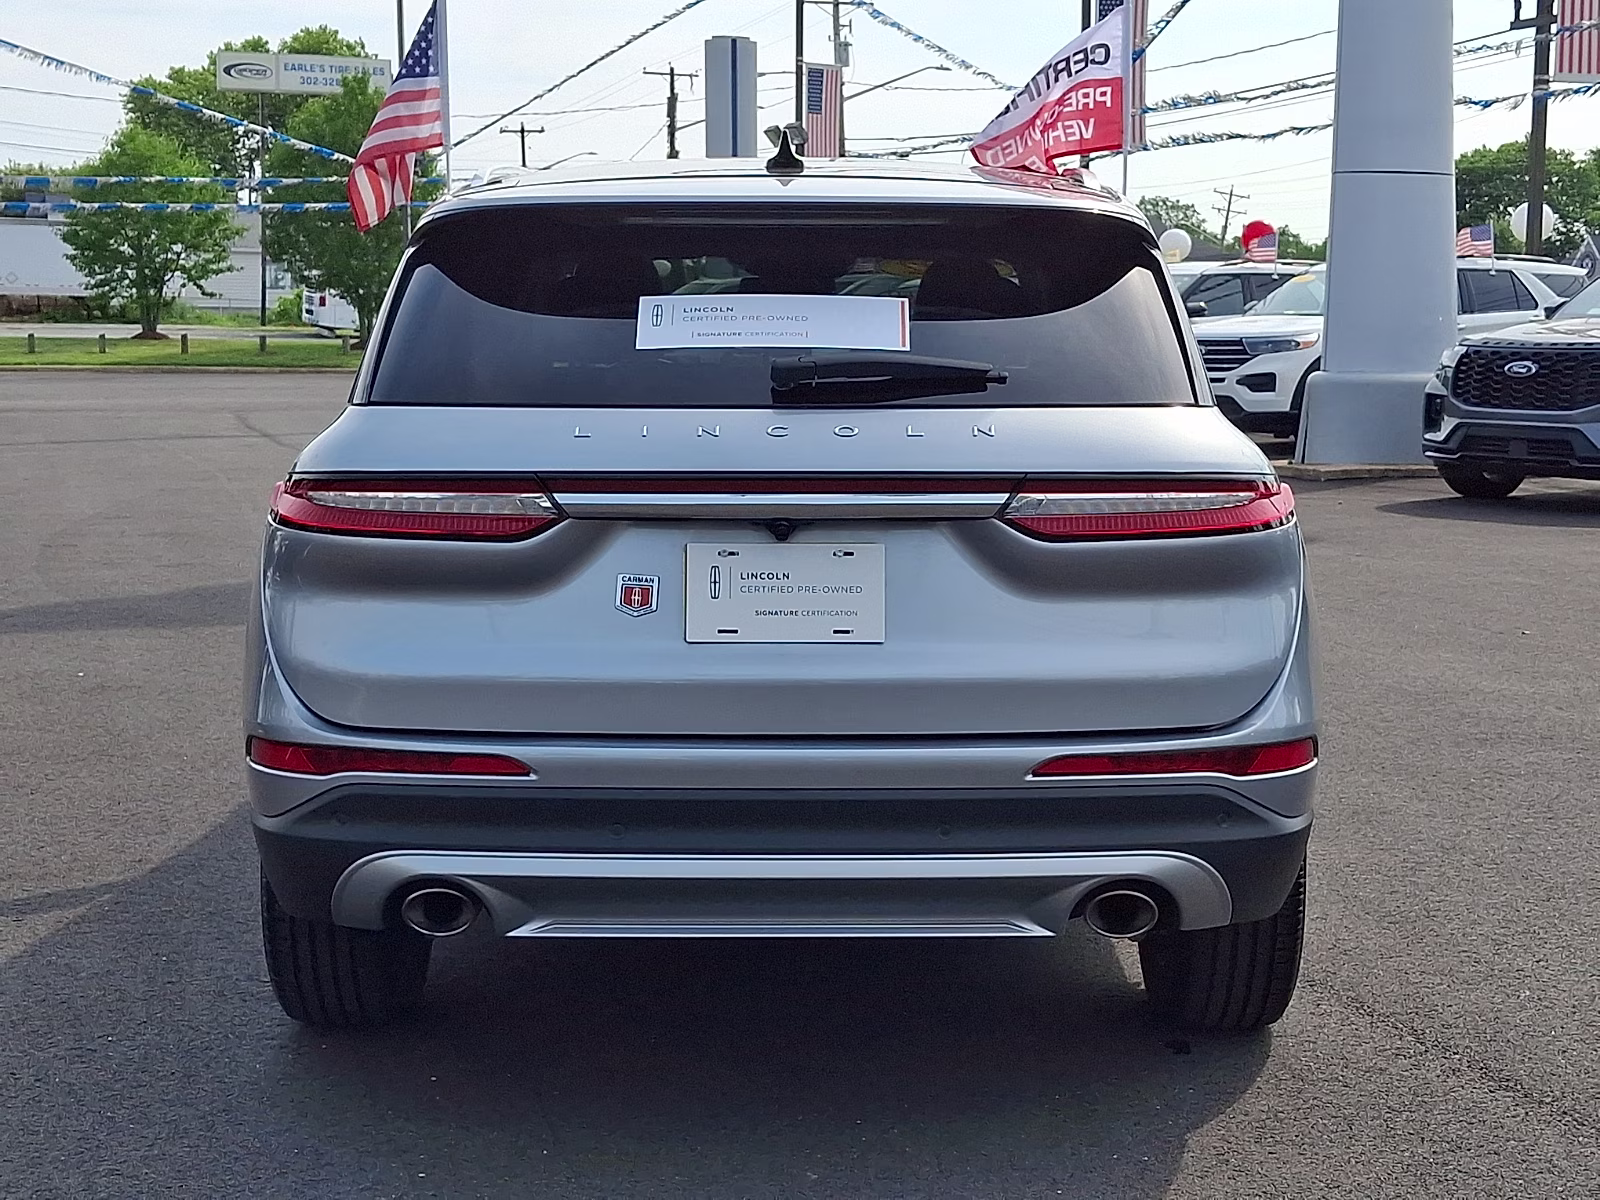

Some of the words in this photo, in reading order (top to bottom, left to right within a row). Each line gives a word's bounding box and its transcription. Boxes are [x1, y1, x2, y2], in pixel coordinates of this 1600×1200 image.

[284, 62, 326, 73] EARLE'S
[329, 65, 350, 74] TIRE
[354, 66, 385, 76] SALES
[683, 306, 734, 314] LINCOLN
[682, 315, 738, 323] CERTIFIED
[573, 424, 996, 438] LINCOLN
[621, 575, 655, 584] CARMAN
[740, 572, 790, 581] LINCOLN
[739, 585, 794, 594] CERTIFIED
[797, 585, 863, 594] PRE-OWNED
